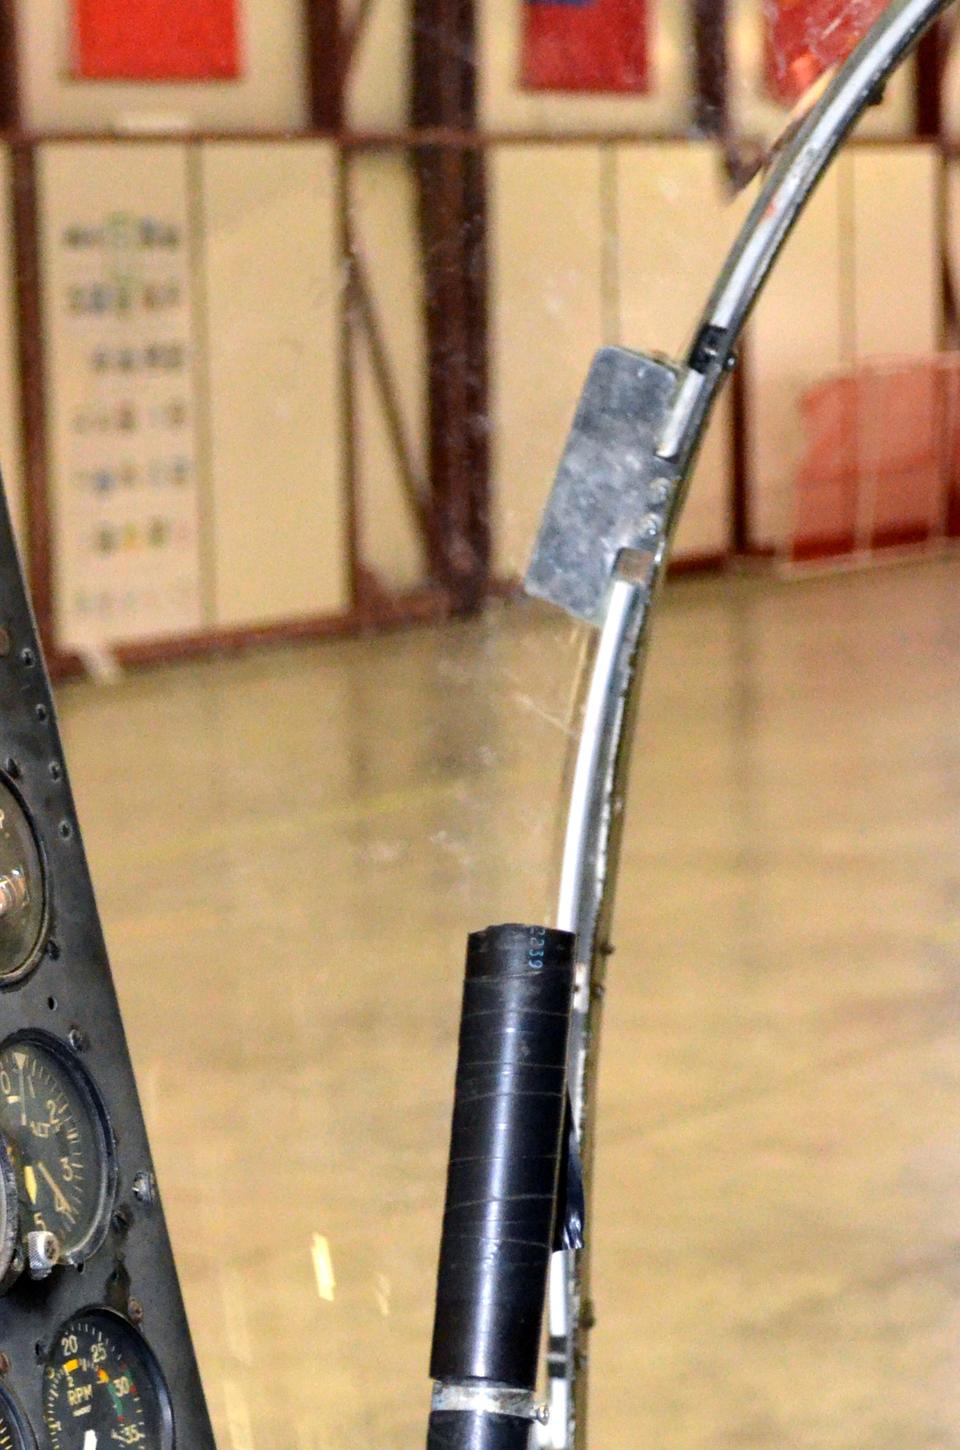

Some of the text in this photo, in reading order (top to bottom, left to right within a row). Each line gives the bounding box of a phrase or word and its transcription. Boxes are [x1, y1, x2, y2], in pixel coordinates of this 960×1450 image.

[61, 1334, 79, 1357] 20
[90, 1342, 108, 1364] 25
[66, 1383, 94, 1407] RPM
[113, 1375, 131, 1398] 30
